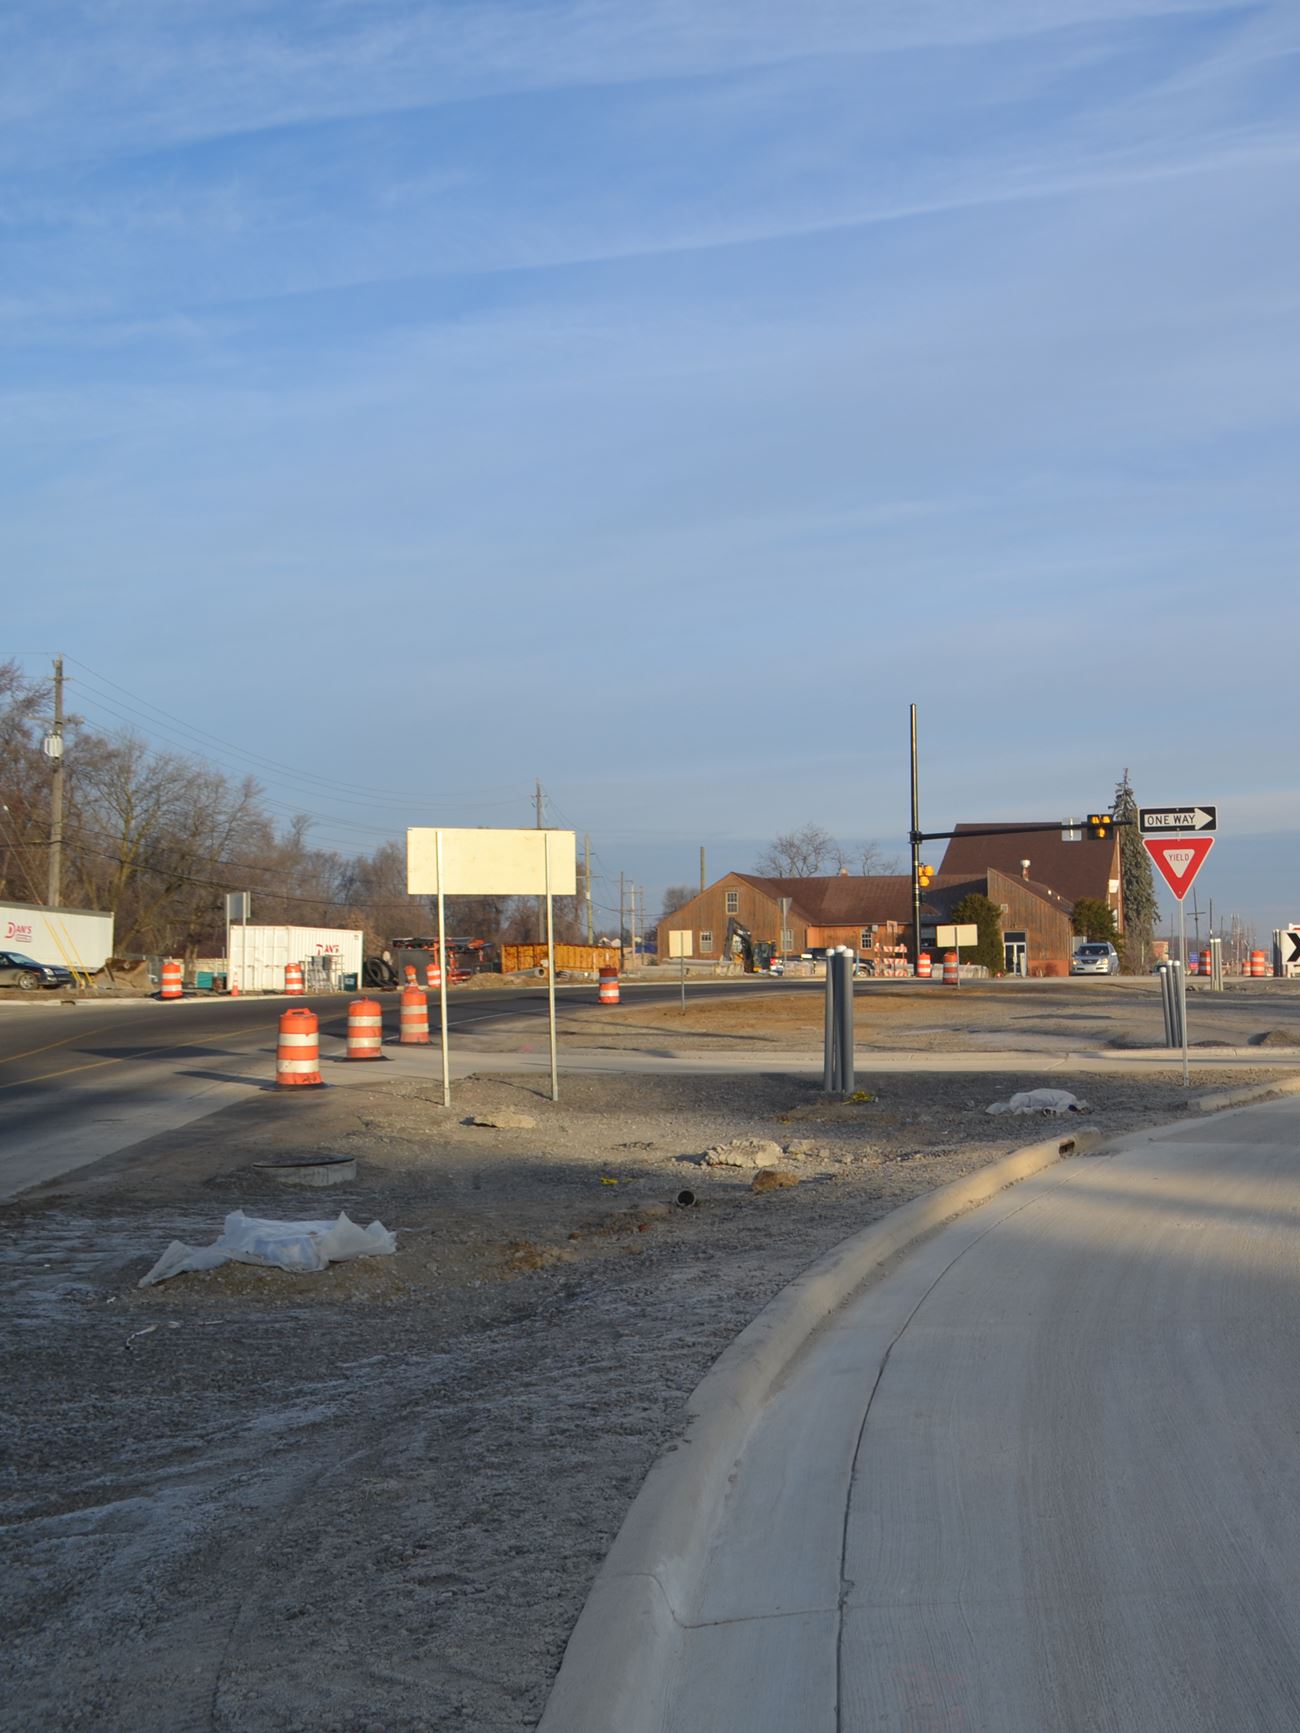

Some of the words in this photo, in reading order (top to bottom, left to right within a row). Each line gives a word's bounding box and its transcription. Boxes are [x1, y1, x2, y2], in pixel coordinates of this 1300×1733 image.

[1147, 815, 1170, 826] ONE
[1173, 814, 1196, 825] WAY
[1168, 853, 1190, 862] YIELD
